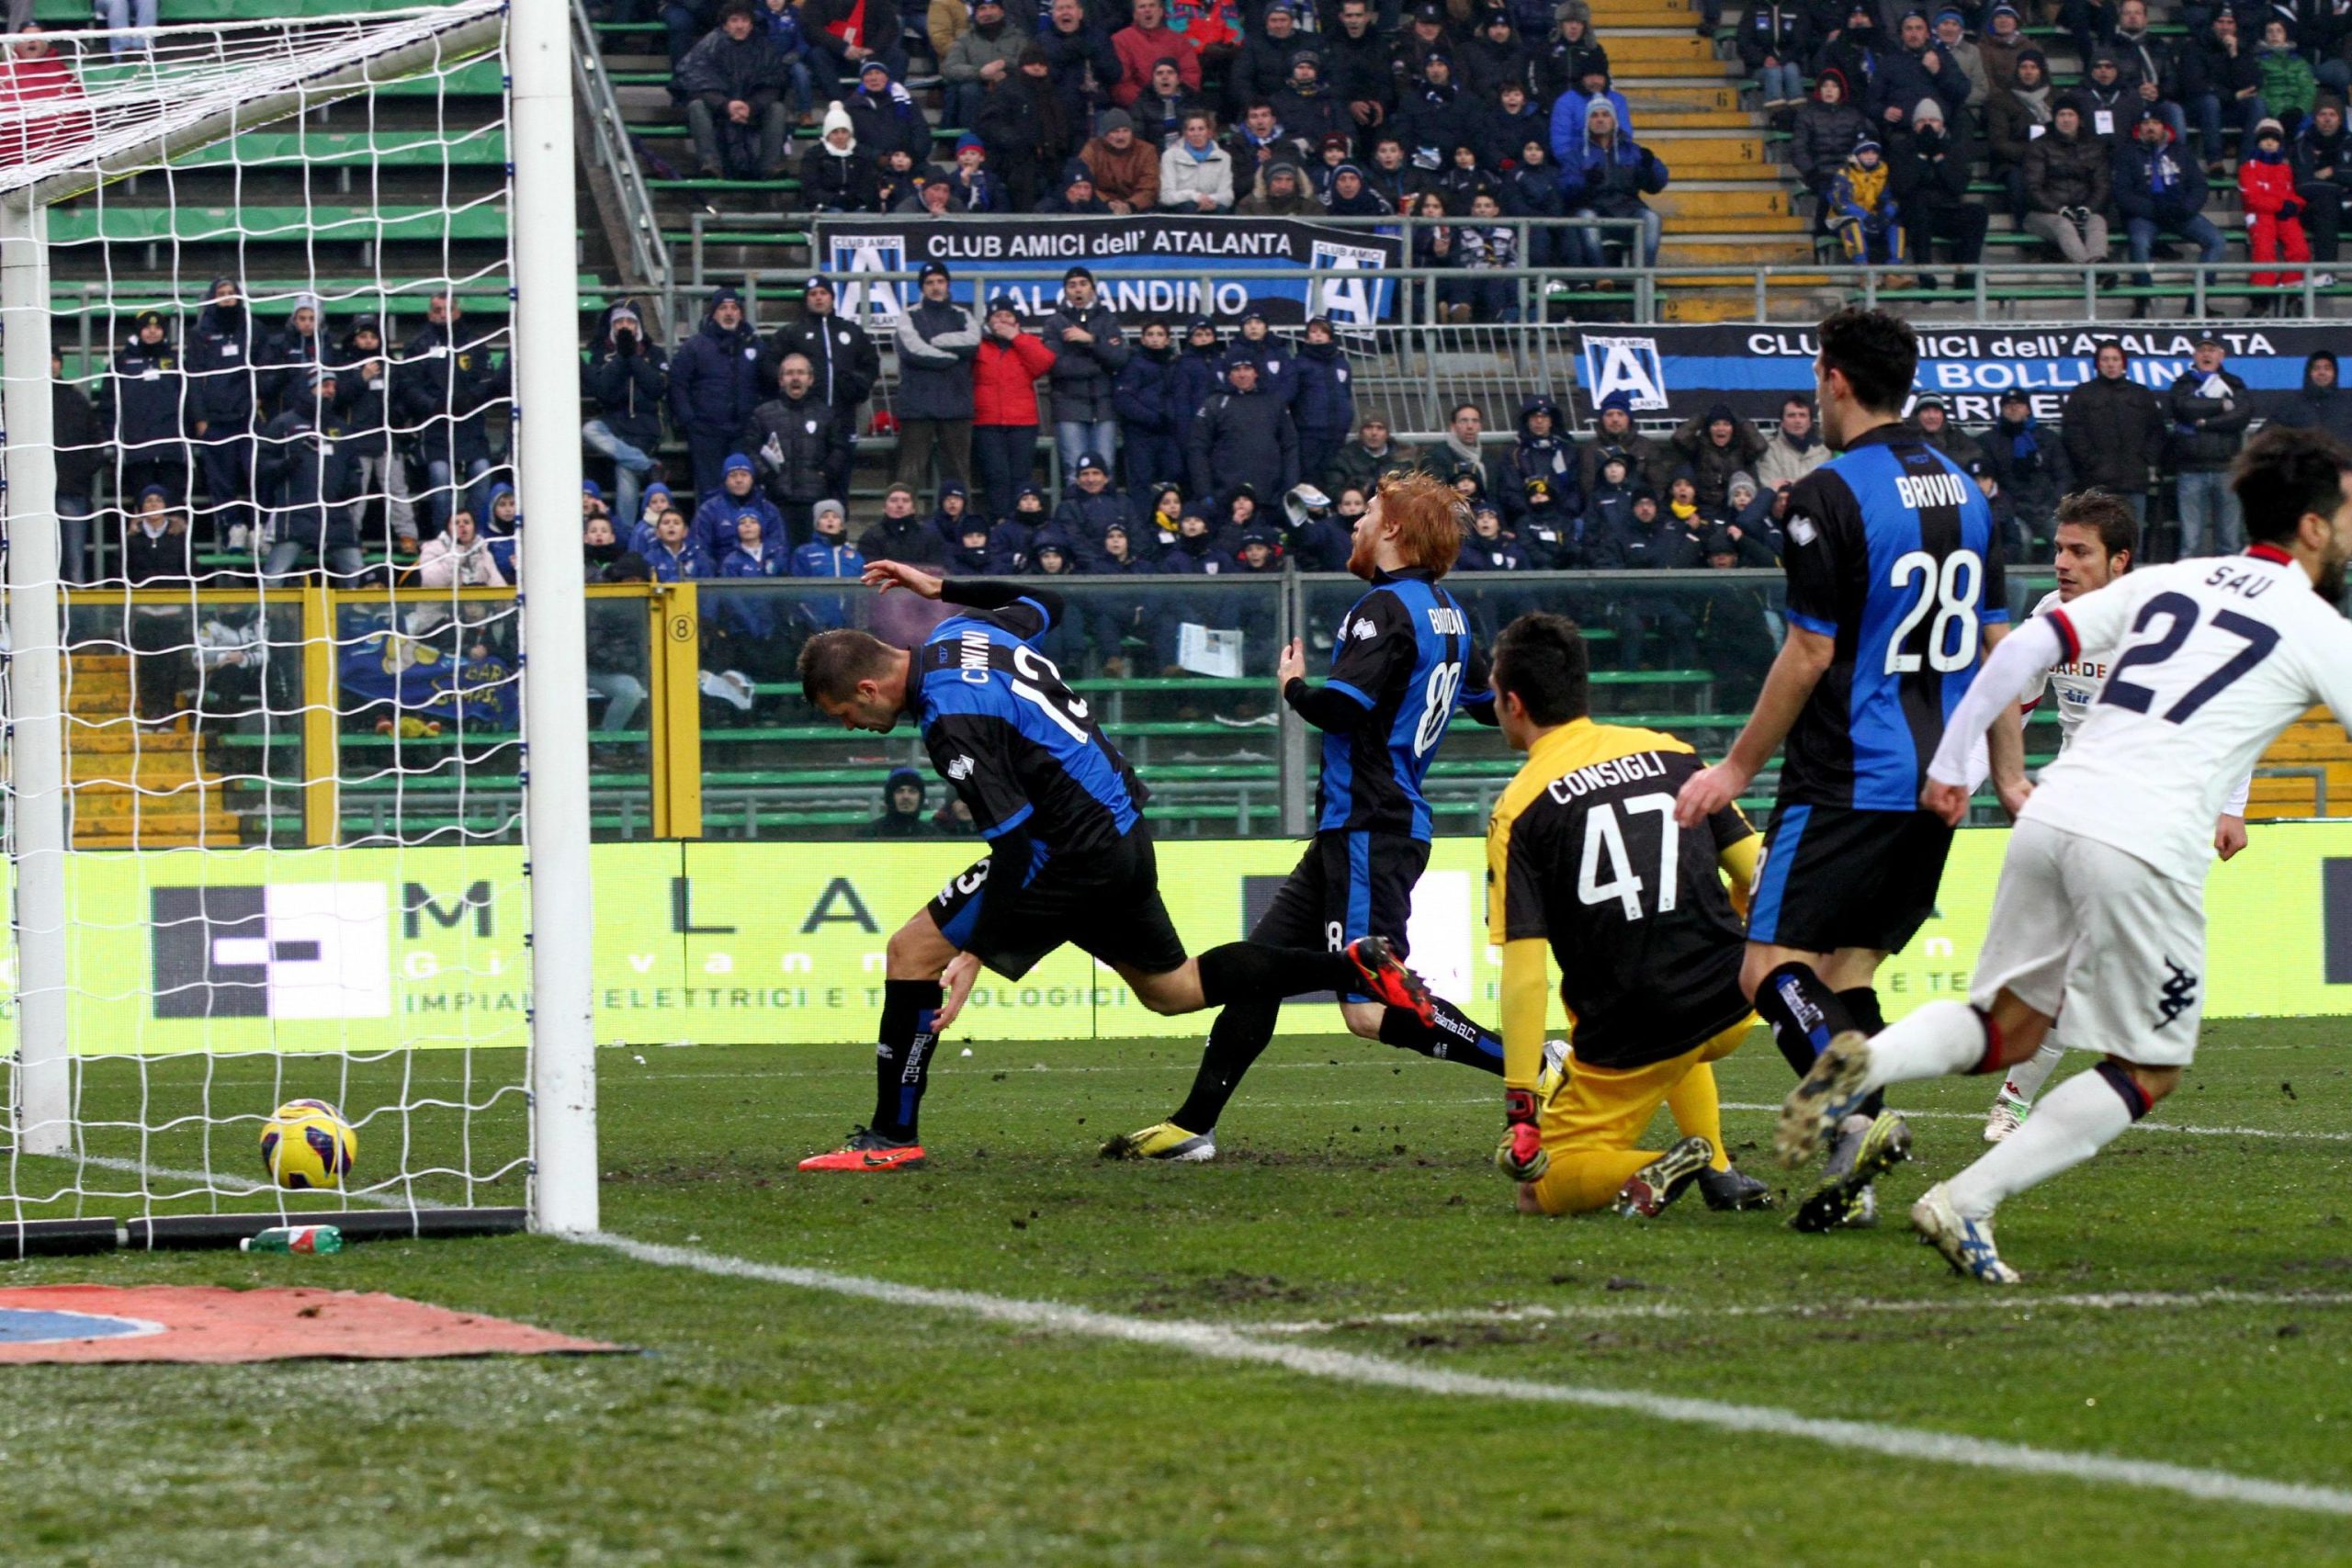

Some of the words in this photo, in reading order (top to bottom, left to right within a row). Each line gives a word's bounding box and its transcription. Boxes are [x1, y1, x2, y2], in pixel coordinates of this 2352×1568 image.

[1768, 196, 1779, 212] 4
[833, 238, 865, 248] CLUB
[868, 238, 900, 248] AMICI
[928, 234, 1001, 258] CLUB
[1009, 233, 1085, 256] AMICI
[1092, 231, 1146, 254] dell'
[1153, 231, 1293, 255] ATALANTA
[1316, 241, 1348, 256] CLUB
[1350, 248, 1383, 261] AMICI
[989, 279, 1249, 316] ALANDINO
[1747, 333, 1820, 355] CLU
[1895, 474, 1968, 509] BRIVIO
[2205, 567, 2274, 599] SAU
[676, 619, 687, 637] 8
[1884, 549, 1983, 676] 28
[2098, 591, 2282, 726] 27
[1547, 750, 1668, 805] CONSIGLI
[1577, 791, 1679, 922] 47
[1324, 920, 1343, 953] 8
[406, 992, 530, 1012] IMPIA
[604, 987, 808, 1009] ELETTRICI
[826, 987, 845, 1009] E
